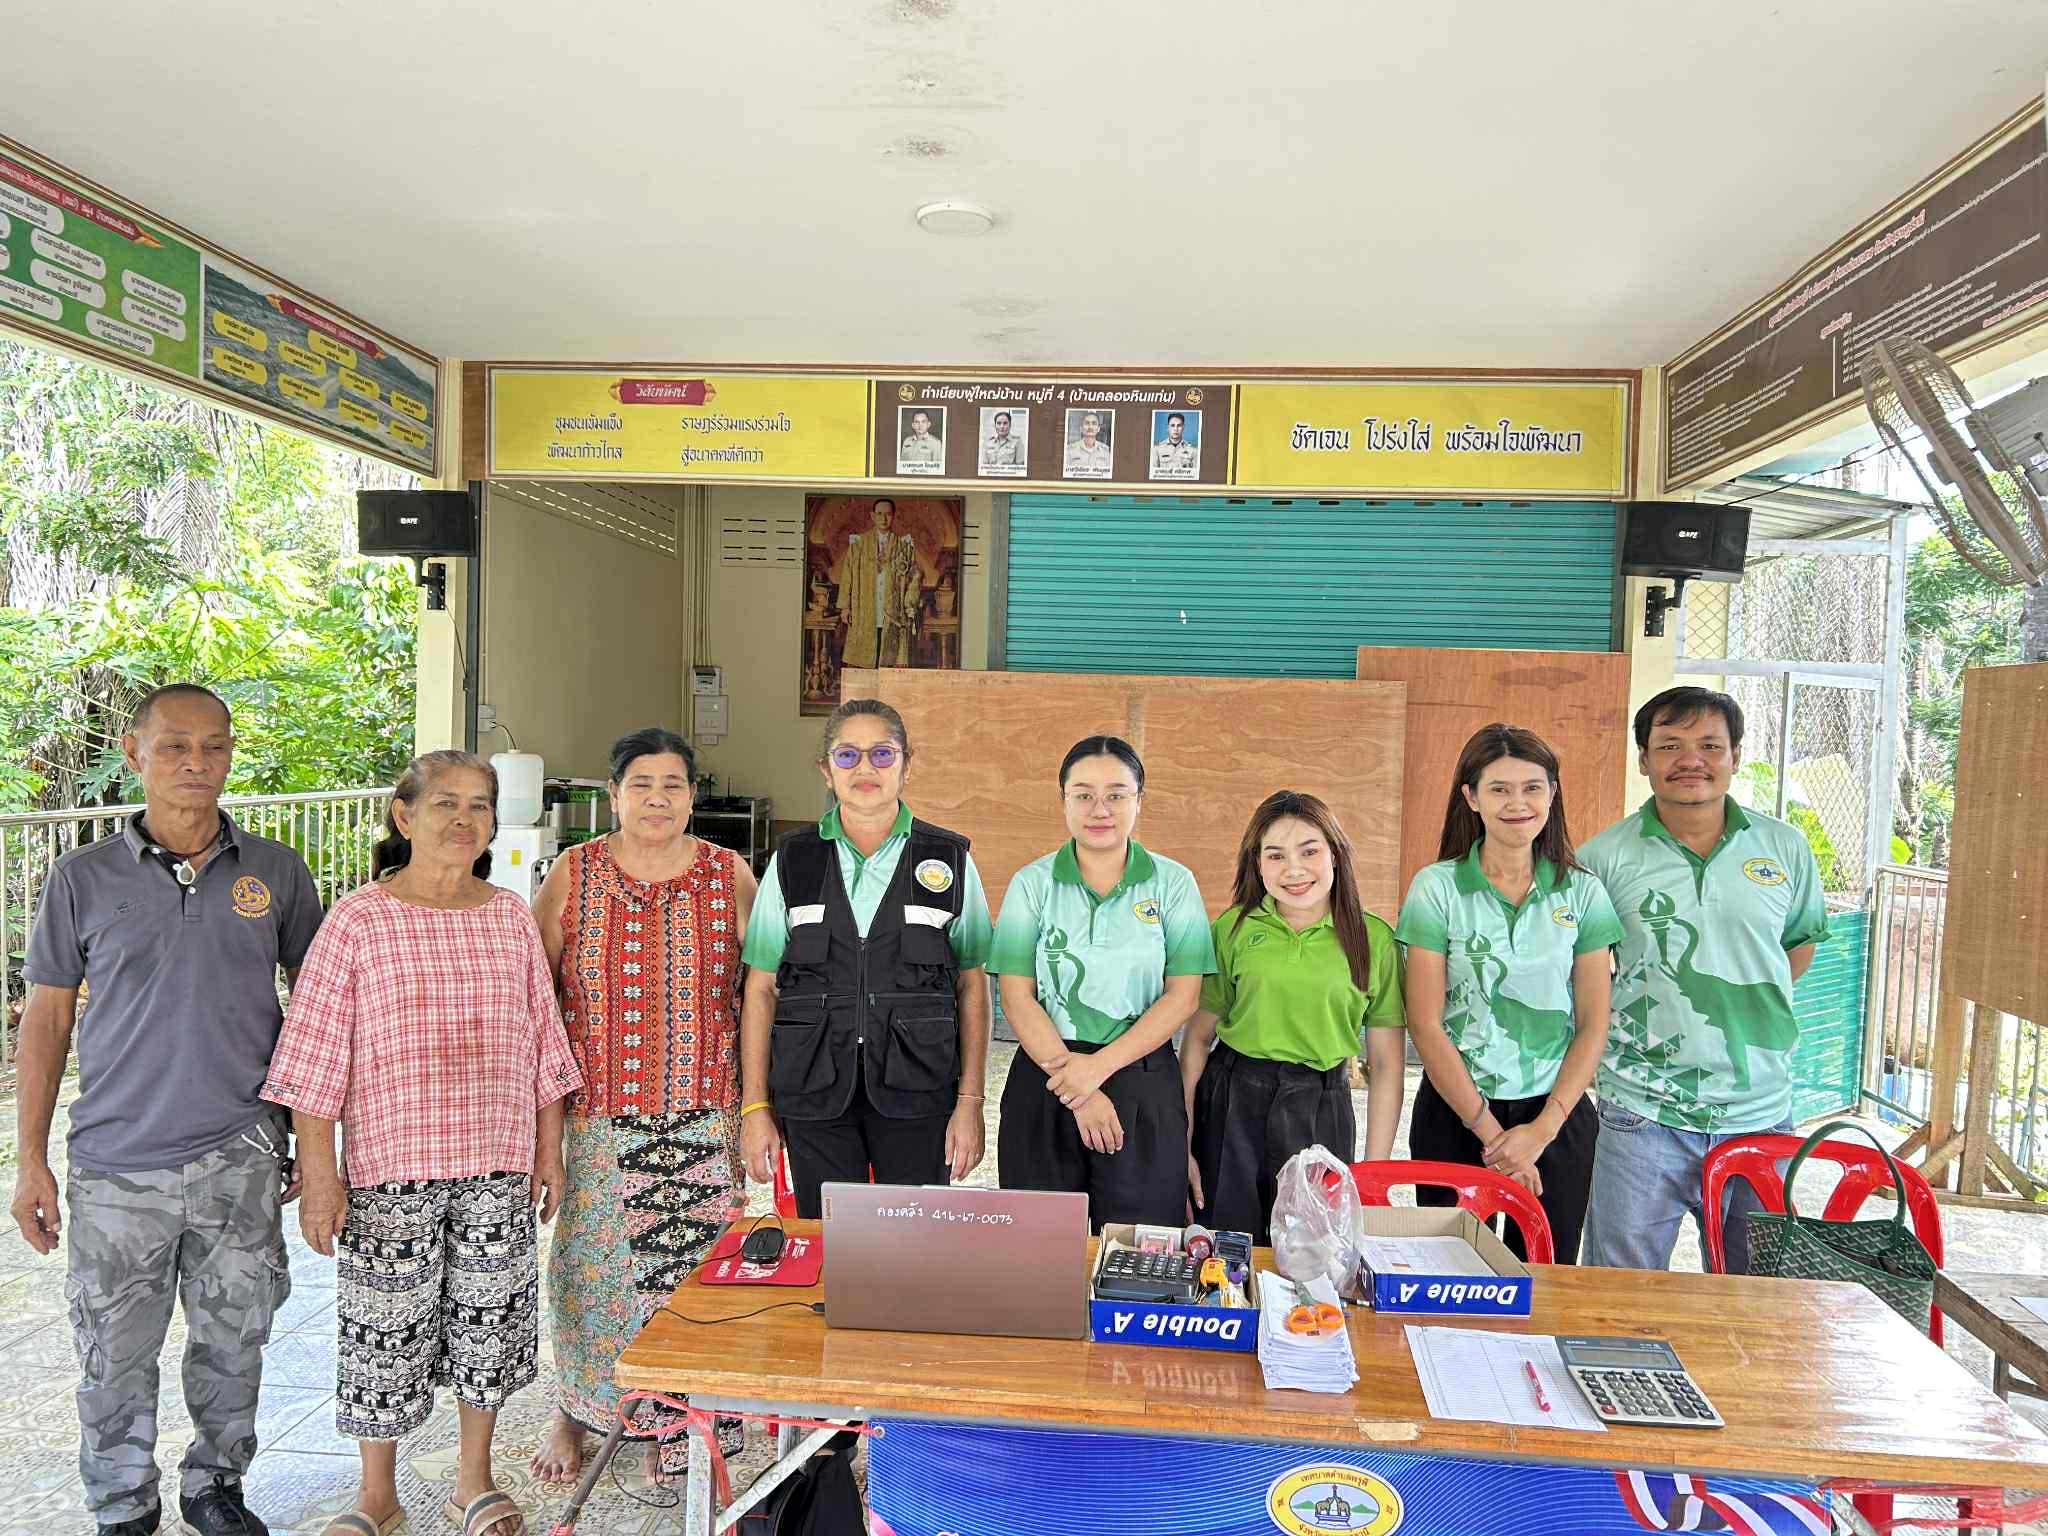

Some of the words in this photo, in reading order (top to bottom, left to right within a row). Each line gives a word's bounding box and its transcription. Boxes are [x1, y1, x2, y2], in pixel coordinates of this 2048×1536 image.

[921, 385, 1023, 403] ทำเนียบผู้ใหญ่บ้าน
[1027, 385, 1055, 404] หมู่ที่
[1056, 389, 1065, 401] 4
[555, 412, 623, 434] ชุมชนเข้มแข็ง
[1292, 424, 1349, 449] ชัดเจน
[1446, 419, 1581, 452] พร้อมใจพัฒนา
[547, 439, 623, 459] พัฒนาก้าวไกล
[681, 443, 764, 467] สู่อนาคตที่ดีกว่า
[877, 1201, 923, 1217] กองคลัง
[1427, 1282, 1519, 1305] Double
[1143, 1312, 1242, 1340] Double
